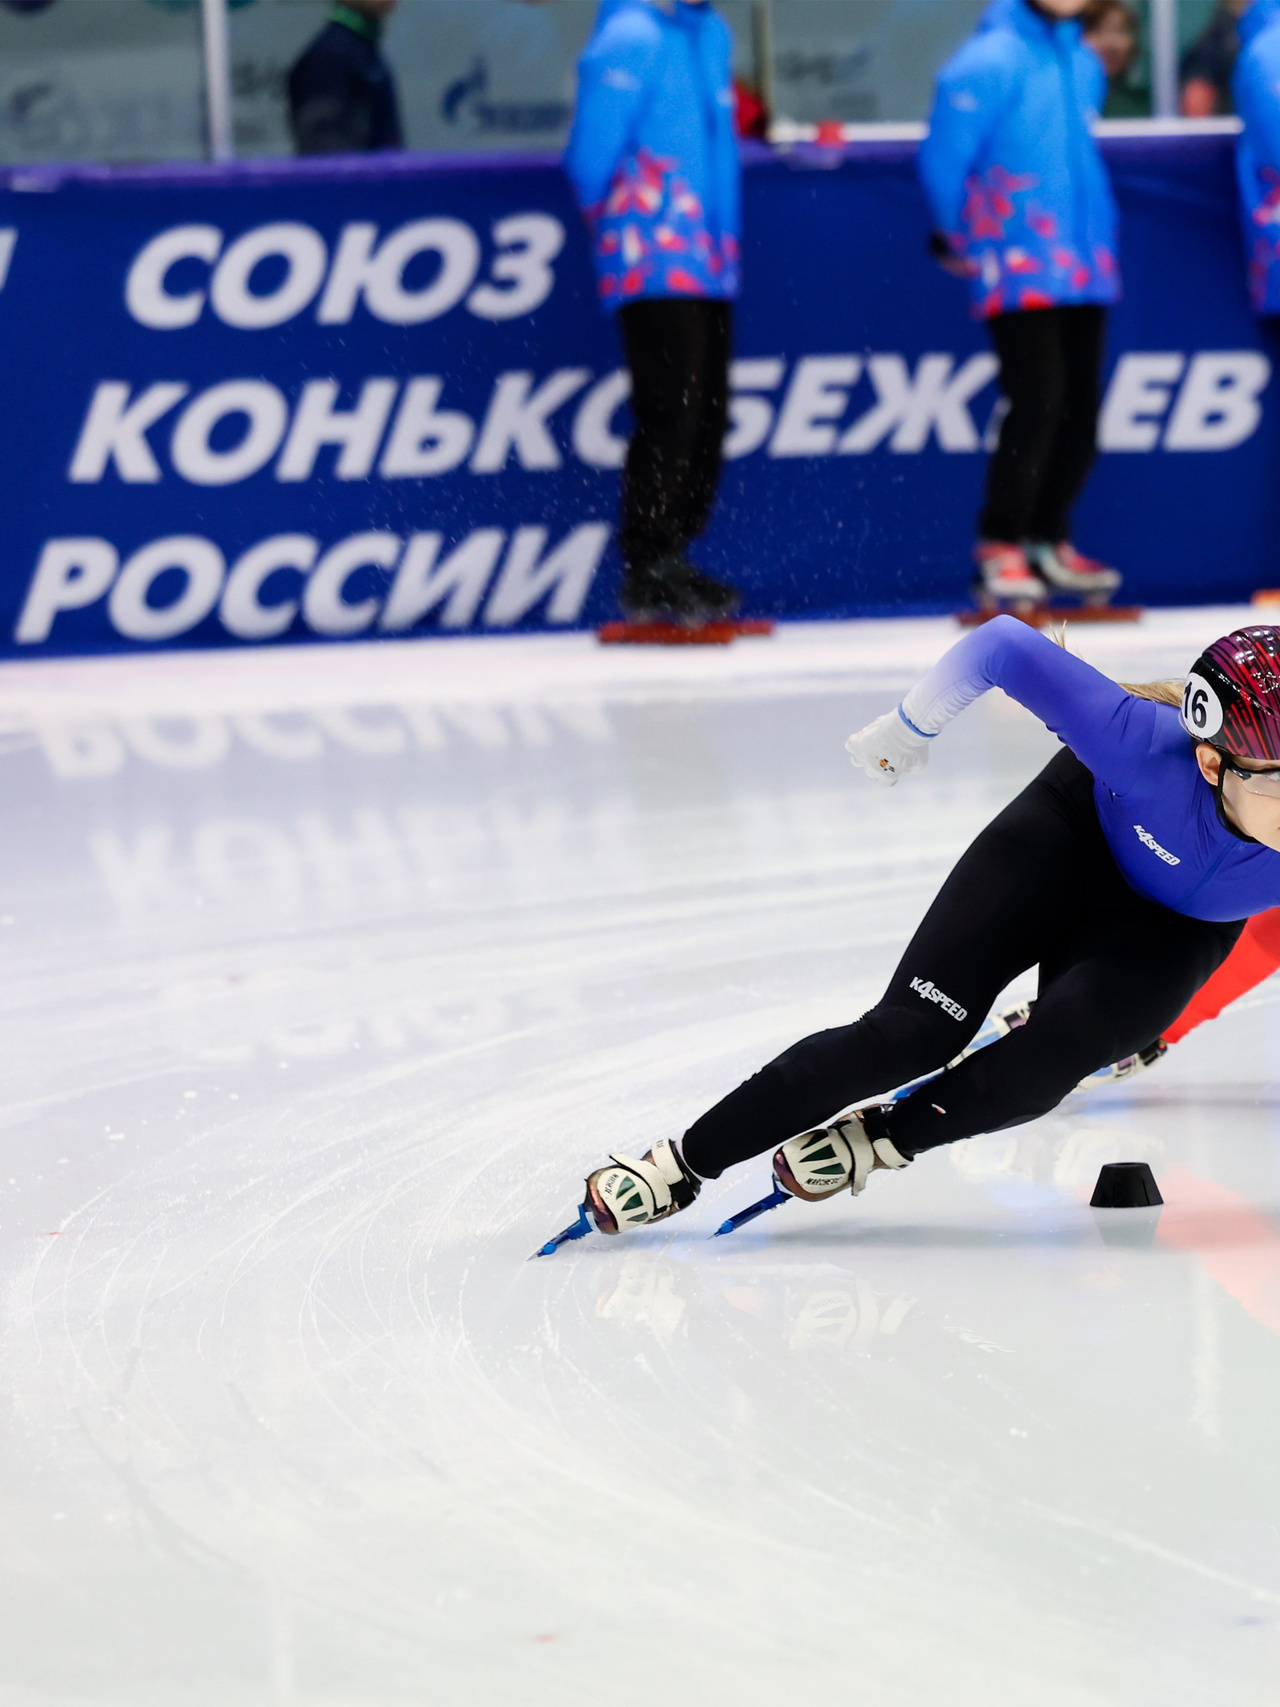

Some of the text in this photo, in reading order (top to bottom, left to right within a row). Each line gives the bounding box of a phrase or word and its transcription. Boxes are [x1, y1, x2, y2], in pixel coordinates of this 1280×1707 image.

[124, 213, 565, 330] СОЮЗ
[67, 350, 1270, 486] КОНЬКБЕЖЕВ
[14, 521, 611, 644] РОССИИ
[1184, 681, 1208, 729] 16
[1133, 824, 1181, 867] K4SPEED
[909, 976, 968, 1022] K4SPEED
